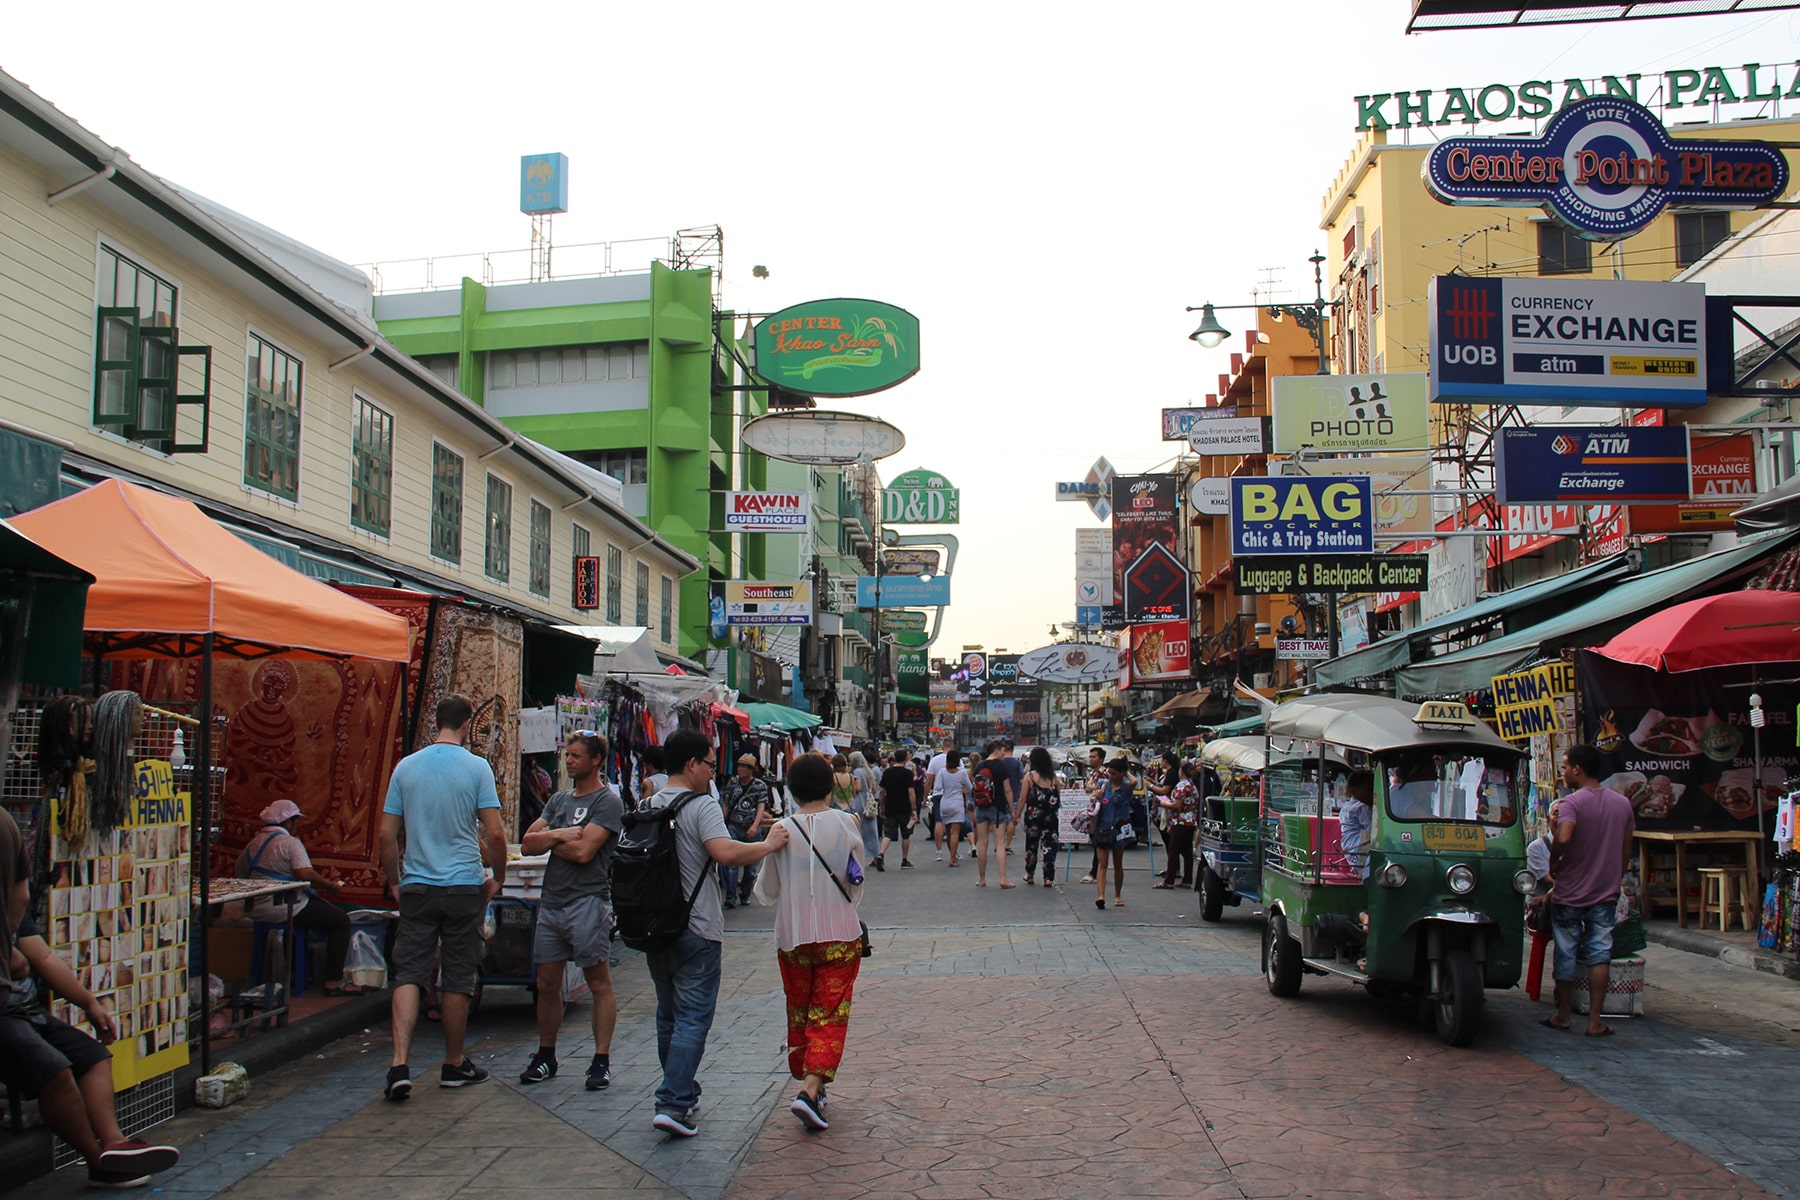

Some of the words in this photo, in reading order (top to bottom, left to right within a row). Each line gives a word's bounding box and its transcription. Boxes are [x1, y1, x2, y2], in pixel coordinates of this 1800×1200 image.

[1354, 73, 1641, 132] KHAOSAN
[1586, 108, 1631, 124] HOTEL
[1447, 147, 1564, 183] Center
[1574, 150, 1669, 186] Point
[1679, 151, 1773, 188] Plaza
[1559, 185, 1626, 222] SHOPPING
[1630, 187, 1662, 217] MALL
[1511, 296, 1594, 311] CURRENCY
[768, 317, 844, 334] CENTER
[1511, 313, 1698, 344] EXCHANGE
[770, 333, 827, 354] Khao
[830, 333, 881, 353] Sarn
[1444, 345, 1497, 365] UOB
[1540, 356, 1577, 372] atm
[1311, 419, 1393, 437] PHOTO
[1193, 436, 1220, 445] KHAOSAN
[1221, 435, 1241, 444] PALACE
[1242, 435, 1260, 443] HOTEL
[1584, 439, 1630, 454] ATM
[1720, 455, 1749, 463] Currency
[1559, 477, 1625, 491] Exchange
[1703, 479, 1750, 495] ATM
[734, 494, 799, 513] KAWIN
[885, 490, 945, 522] D&D
[949, 490, 957, 521] INN
[1135, 499, 1152, 507] LEO
[1242, 482, 1362, 522] BAG
[729, 515, 804, 523] GUESTHOUSE
[1242, 531, 1268, 547] Chic
[1272, 531, 1283, 547] &
[1286, 530, 1312, 549] Trip
[1317, 530, 1362, 547] Station
[1240, 565, 1292, 593] Luggage
[1298, 563, 1308, 586] &
[1313, 562, 1373, 591] Backpack
[1379, 561, 1422, 585] Center
[743, 587, 794, 599] Southeast
[1166, 641, 1187, 657] LEO
[1279, 641, 1301, 651] BEST
[1031, 651, 1066, 677] The
[1494, 673, 1552, 706] HENNA
[1429, 705, 1464, 719] TAXI
[1728, 712, 1791, 725] FAFEL
[1498, 705, 1556, 738] HENNA
[1704, 736, 1738, 748] VEGAN
[1625, 760, 1690, 771] SANDWICH
[138, 799, 185, 825] HENNA
[1454, 827, 1479, 840] 604
